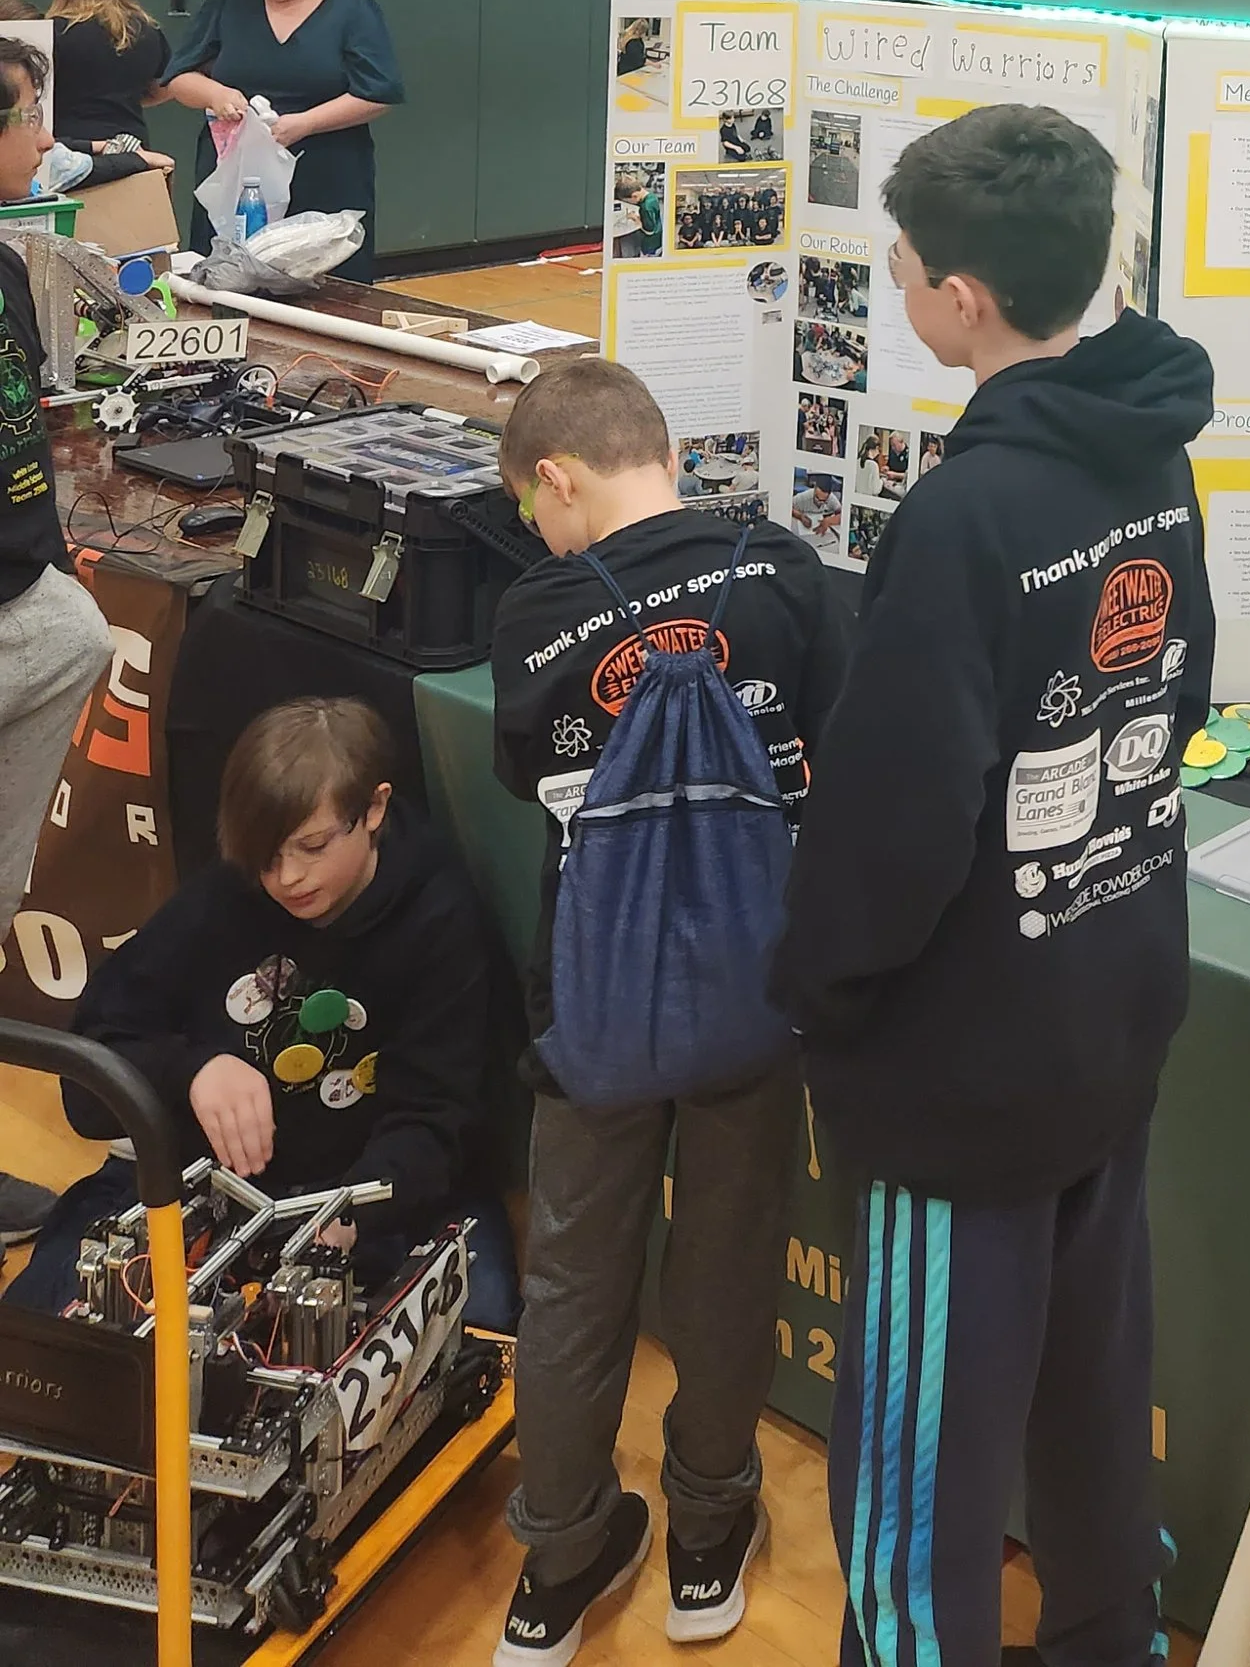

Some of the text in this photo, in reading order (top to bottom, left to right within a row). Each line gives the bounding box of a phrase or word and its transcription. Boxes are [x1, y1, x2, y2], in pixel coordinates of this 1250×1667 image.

[700, 21, 781, 55] Team
[824, 27, 1097, 87] Wired Warriors
[688, 78, 787, 108] 23168
[807, 76, 899, 103] The Challenge
[615, 138, 697, 154] Our Team
[800, 235, 869, 256] Our Robot
[134, 325, 245, 360] 22601
[1020, 548, 1088, 593] Thank
[1125, 516, 1155, 539] our
[307, 563, 349, 589] 23168
[524, 630, 576, 673] Thank
[577, 609, 614, 642] you
[646, 584, 681, 607] our
[1118, 727, 1164, 767] DQ
[1040, 756, 1088, 782] ARCADE
[1016, 785, 1065, 805] Grand
[1016, 804, 1063, 821] Lanes
[1093, 864, 1142, 897] POWDER
[1142, 849, 1174, 874] COAT
[679, 1579, 723, 1602] FILA
[508, 1616, 548, 1640] FILA
